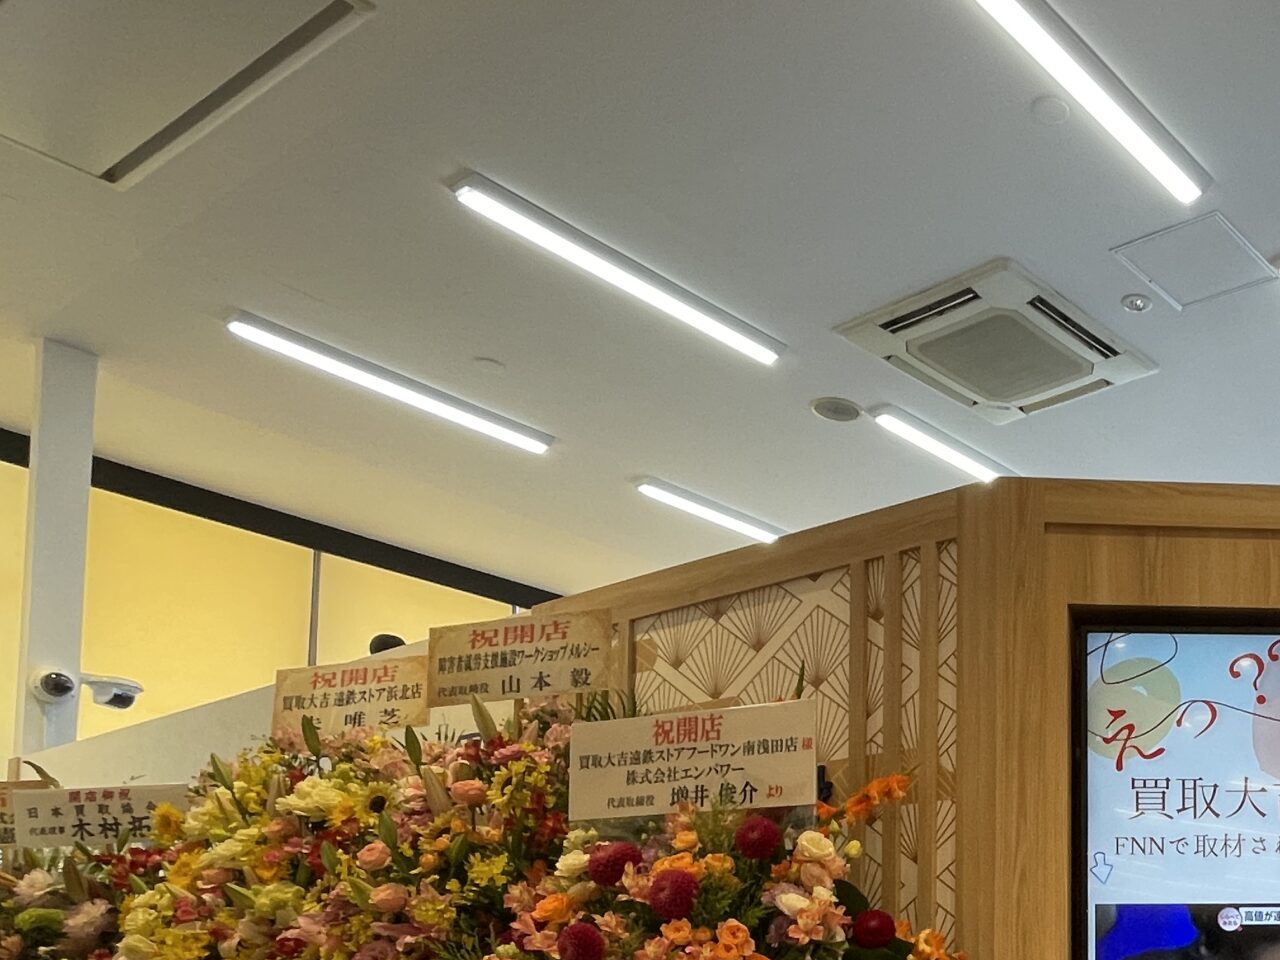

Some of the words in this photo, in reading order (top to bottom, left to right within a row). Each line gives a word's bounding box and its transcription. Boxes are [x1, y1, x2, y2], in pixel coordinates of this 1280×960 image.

[469, 620, 571, 649] 祝開店
[310, 665, 399, 689] 祝開店
[652, 714, 724, 746] 祝開店
[626, 763, 745, 786] 株式会社エンパワー
[766, 784, 784, 800] より
